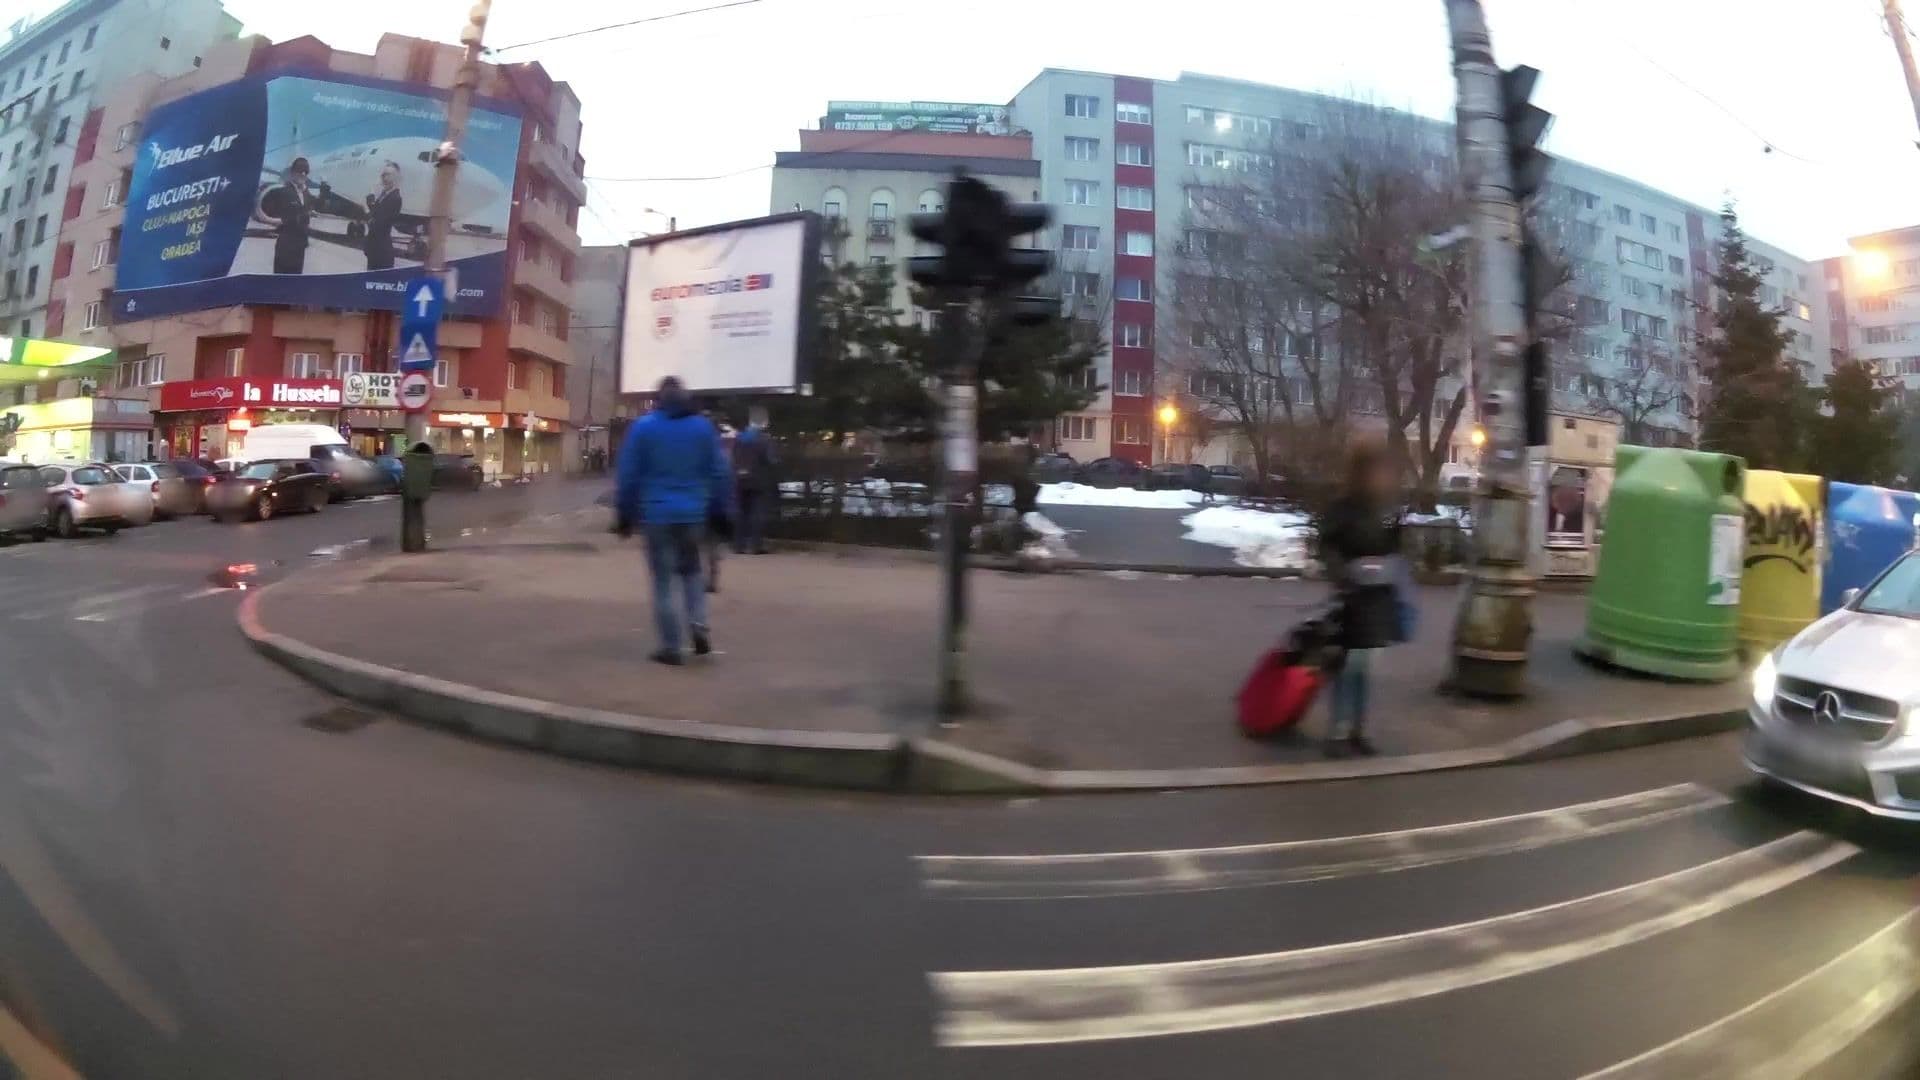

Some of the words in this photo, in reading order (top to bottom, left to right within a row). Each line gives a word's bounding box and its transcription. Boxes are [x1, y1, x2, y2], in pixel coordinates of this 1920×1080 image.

[157, 144, 204, 169] Blue
[203, 133, 239, 155] Air
[161, 240, 201, 260] ORADEA
[272, 383, 340, 403] Hussein
